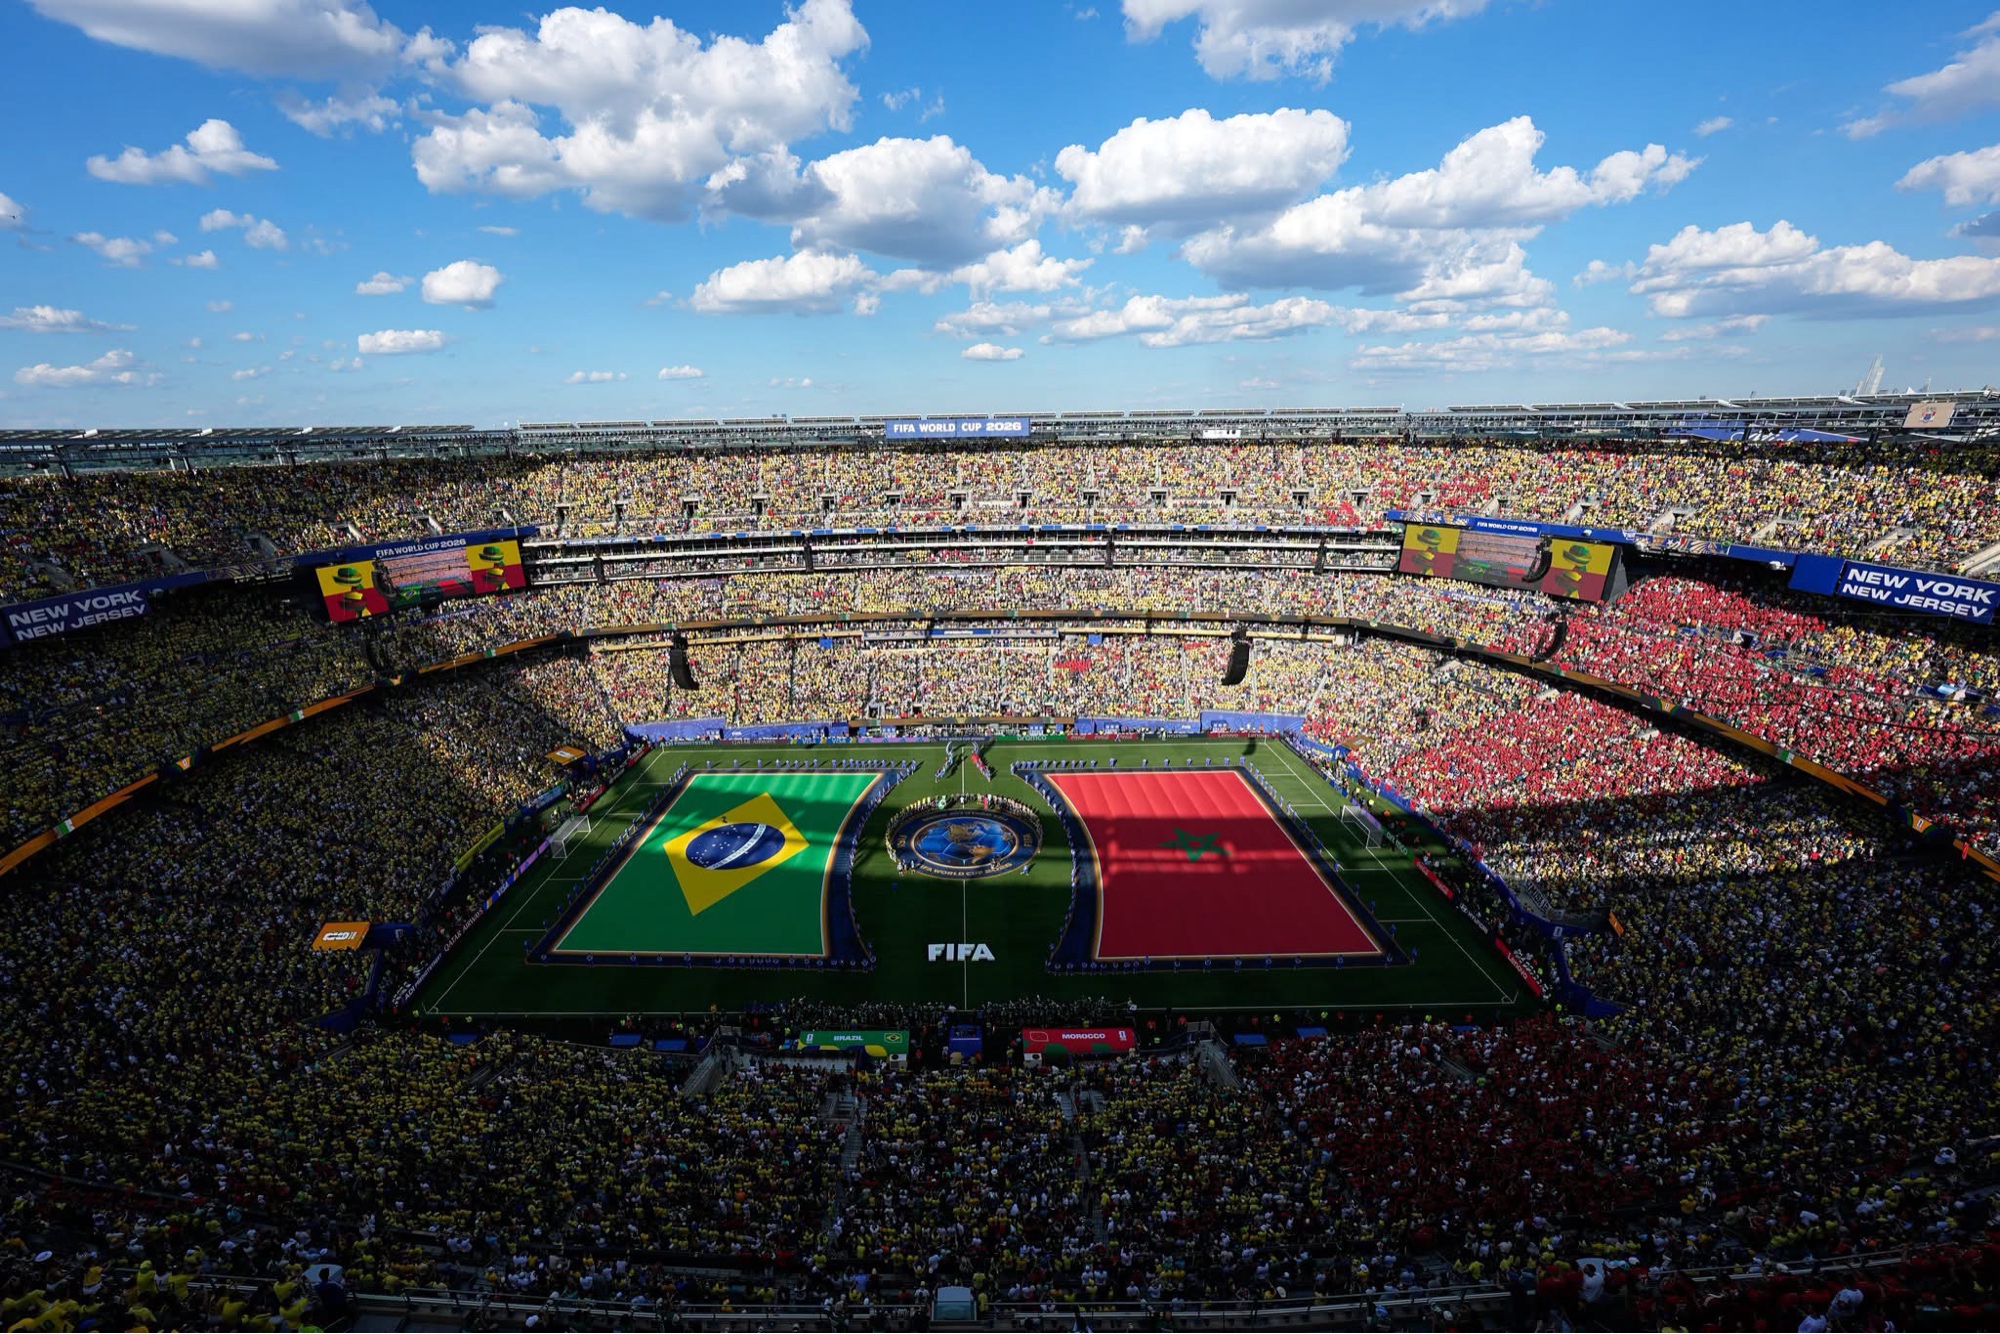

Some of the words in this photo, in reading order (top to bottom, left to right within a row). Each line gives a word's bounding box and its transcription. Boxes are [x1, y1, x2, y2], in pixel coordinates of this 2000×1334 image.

[893, 424, 916, 433] FIFA
[919, 423, 956, 433] WORLD
[961, 423, 982, 432] CUP
[985, 421, 1022, 431] 2026
[376, 549, 394, 557] FIFA
[394, 544, 424, 554] WORLD
[425, 542, 440, 550] CUP
[440, 538, 467, 547] 2026
[1842, 583, 1891, 600] NEW
[1894, 594, 1988, 617] JERSEY
[1847, 568, 1910, 589] NEW
[1915, 579, 1997, 604] YORK
[9, 603, 69, 627] NEW
[74, 590, 144, 613] YORK
[15, 620, 65, 642] NEW
[70, 604, 146, 629] JERSEY
[927, 943, 996, 962] FIFA
[1507, 952, 1528, 979] Lenovo
